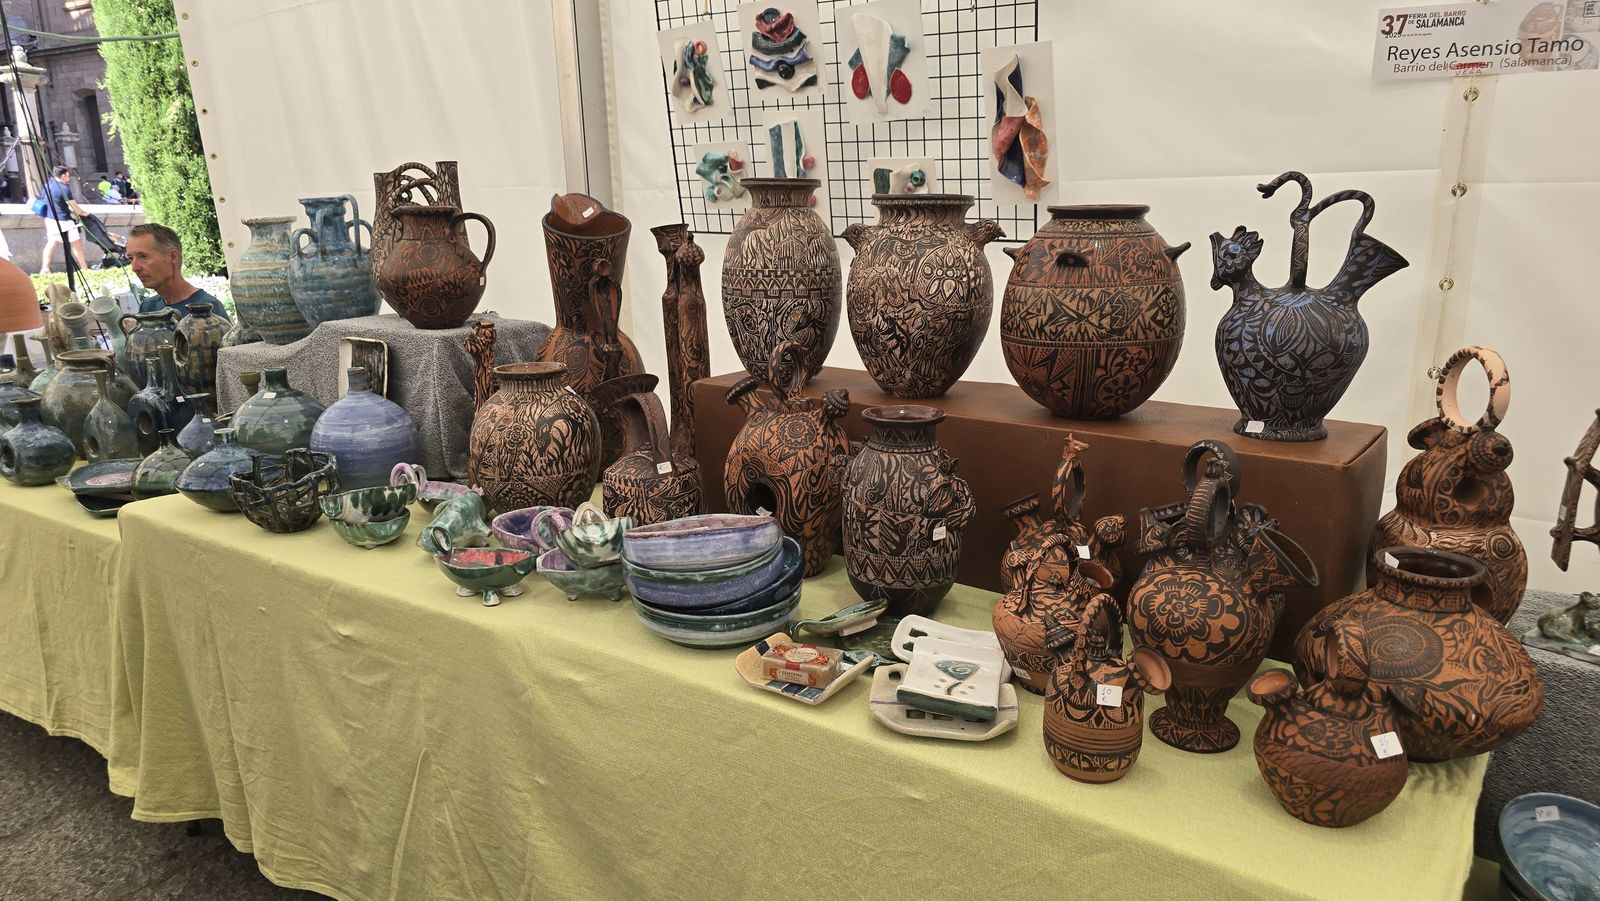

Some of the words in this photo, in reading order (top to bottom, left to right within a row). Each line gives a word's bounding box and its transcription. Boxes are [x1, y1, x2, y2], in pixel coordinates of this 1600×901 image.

[1380, 14, 1408, 36] 37
[1416, 16, 1464, 28] SALAMANCA
[1388, 46, 1440, 64] Reyes
[1446, 40, 1522, 58] Asensio
[1528, 37, 1584, 54] Tamo
[1394, 62, 1426, 73] Barrio
[1500, 56, 1572, 69] (Salamanca)
